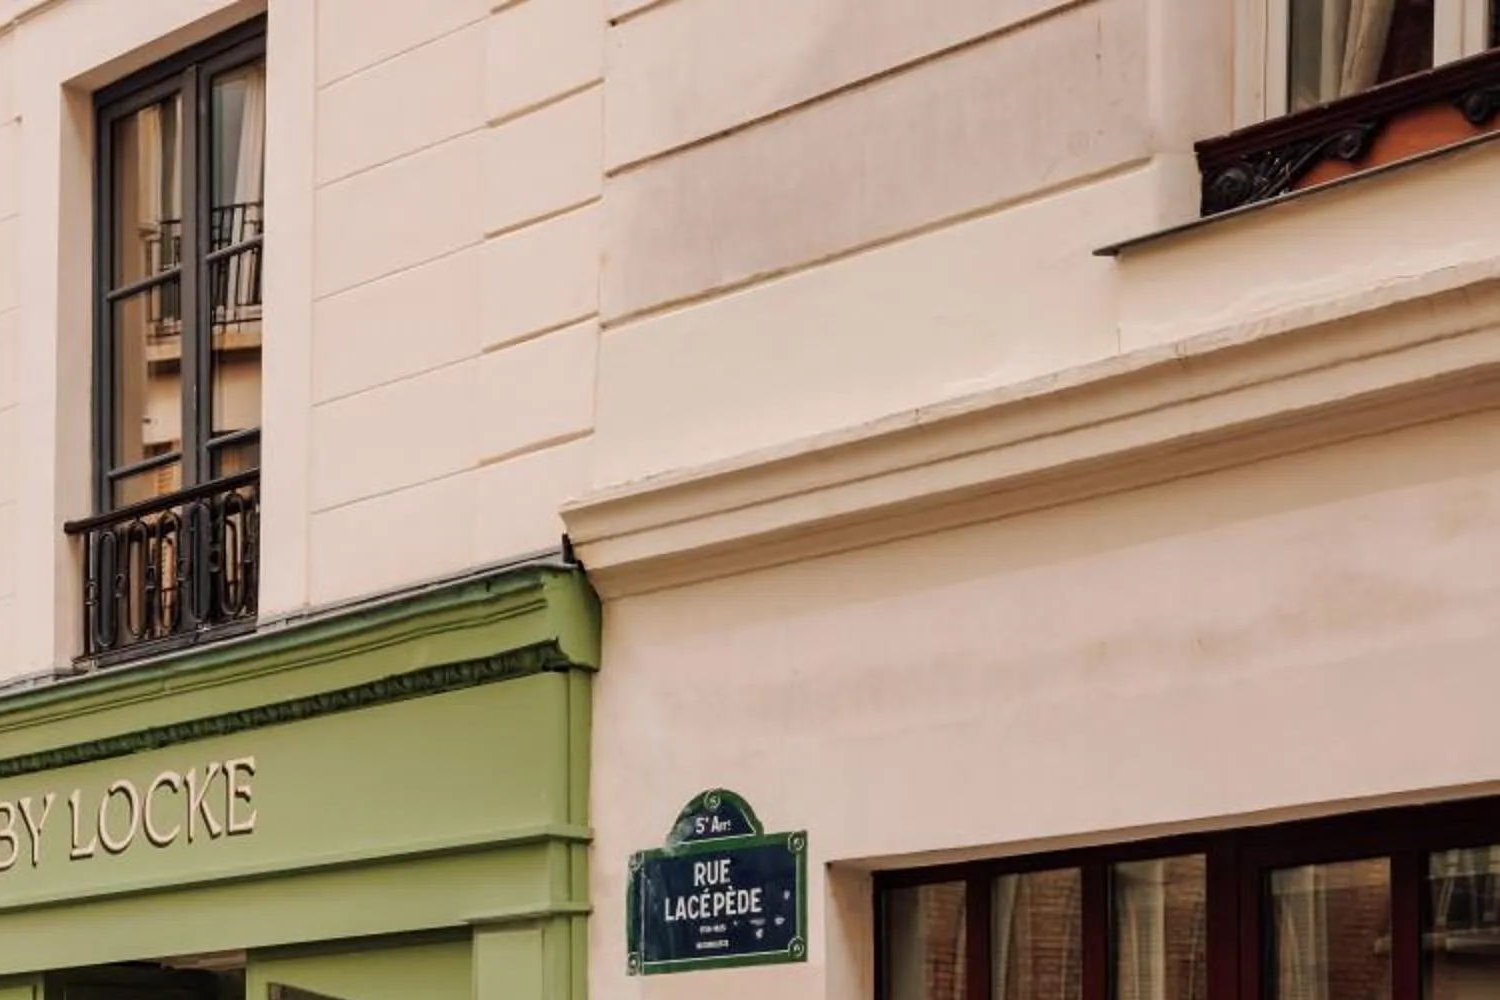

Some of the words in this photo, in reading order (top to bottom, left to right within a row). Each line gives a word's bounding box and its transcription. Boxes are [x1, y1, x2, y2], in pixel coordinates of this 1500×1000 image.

[67, 755, 258, 861] LOCKE
[694, 860, 731, 886] RUE
[665, 886, 762, 921] LACÉPÈDE
